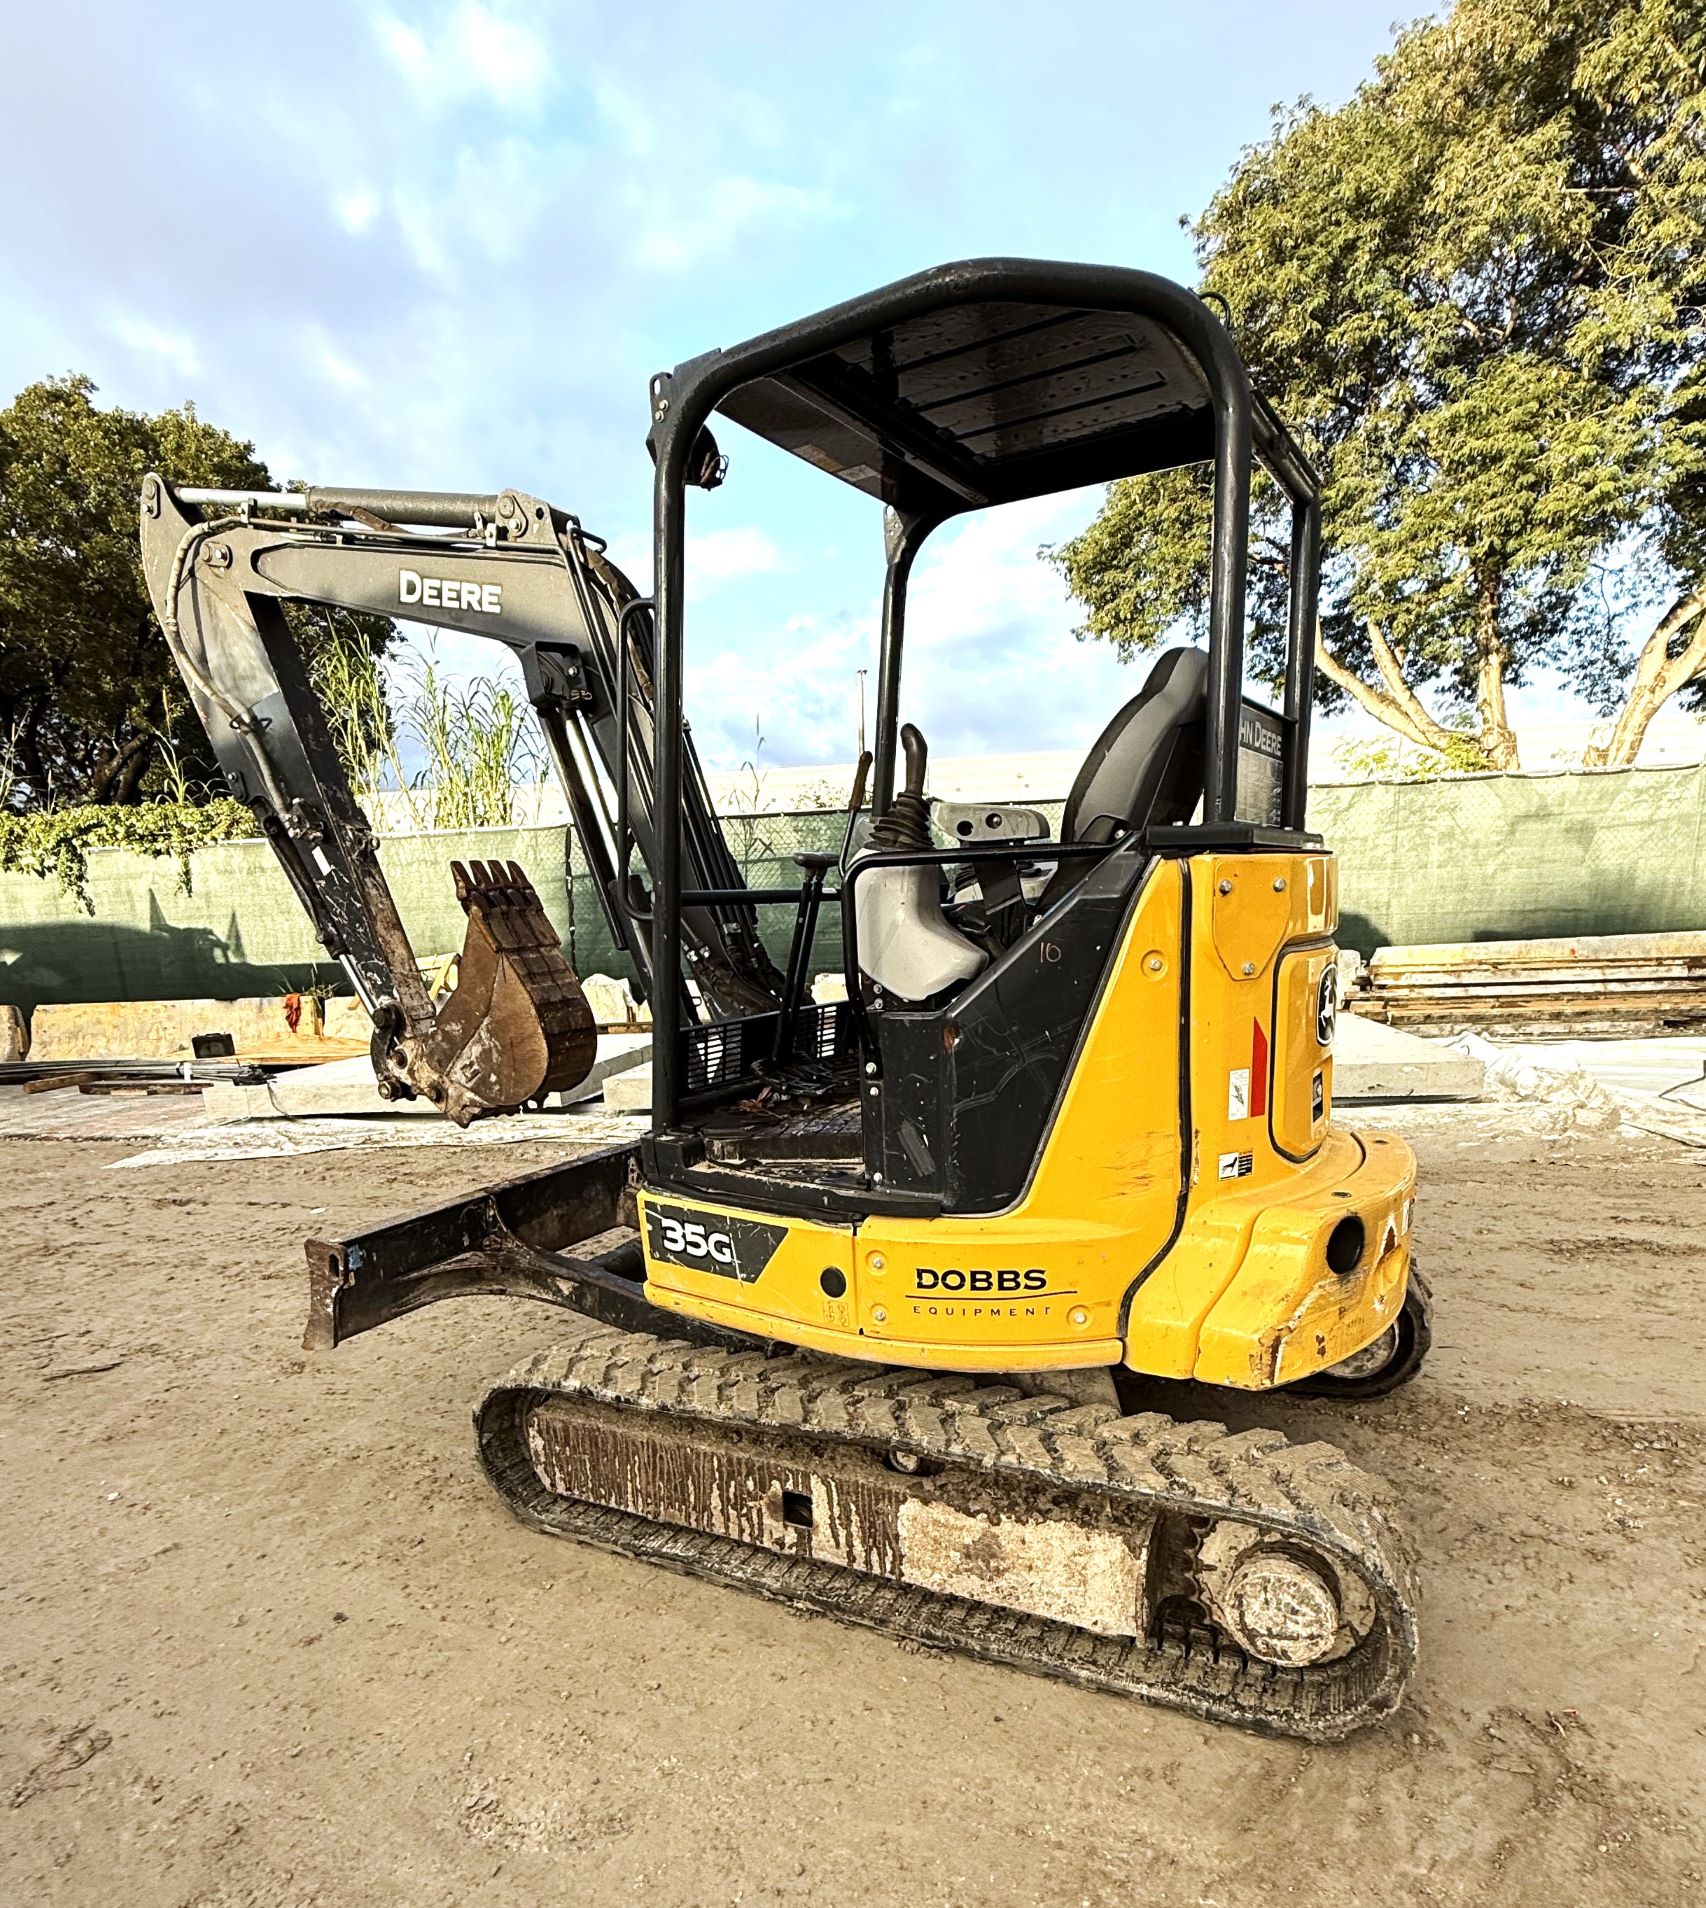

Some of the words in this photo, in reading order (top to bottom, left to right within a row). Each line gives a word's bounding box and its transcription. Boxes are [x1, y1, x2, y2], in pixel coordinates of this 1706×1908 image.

[399, 569, 502, 614] DEERE
[1239, 720, 1254, 745] HN
[1254, 721, 1282, 756] DEERE
[661, 1217, 733, 1263] 35G
[916, 1268, 1047, 1291] DOBBS
[913, 1305, 1051, 1317] EQUIPMENT
